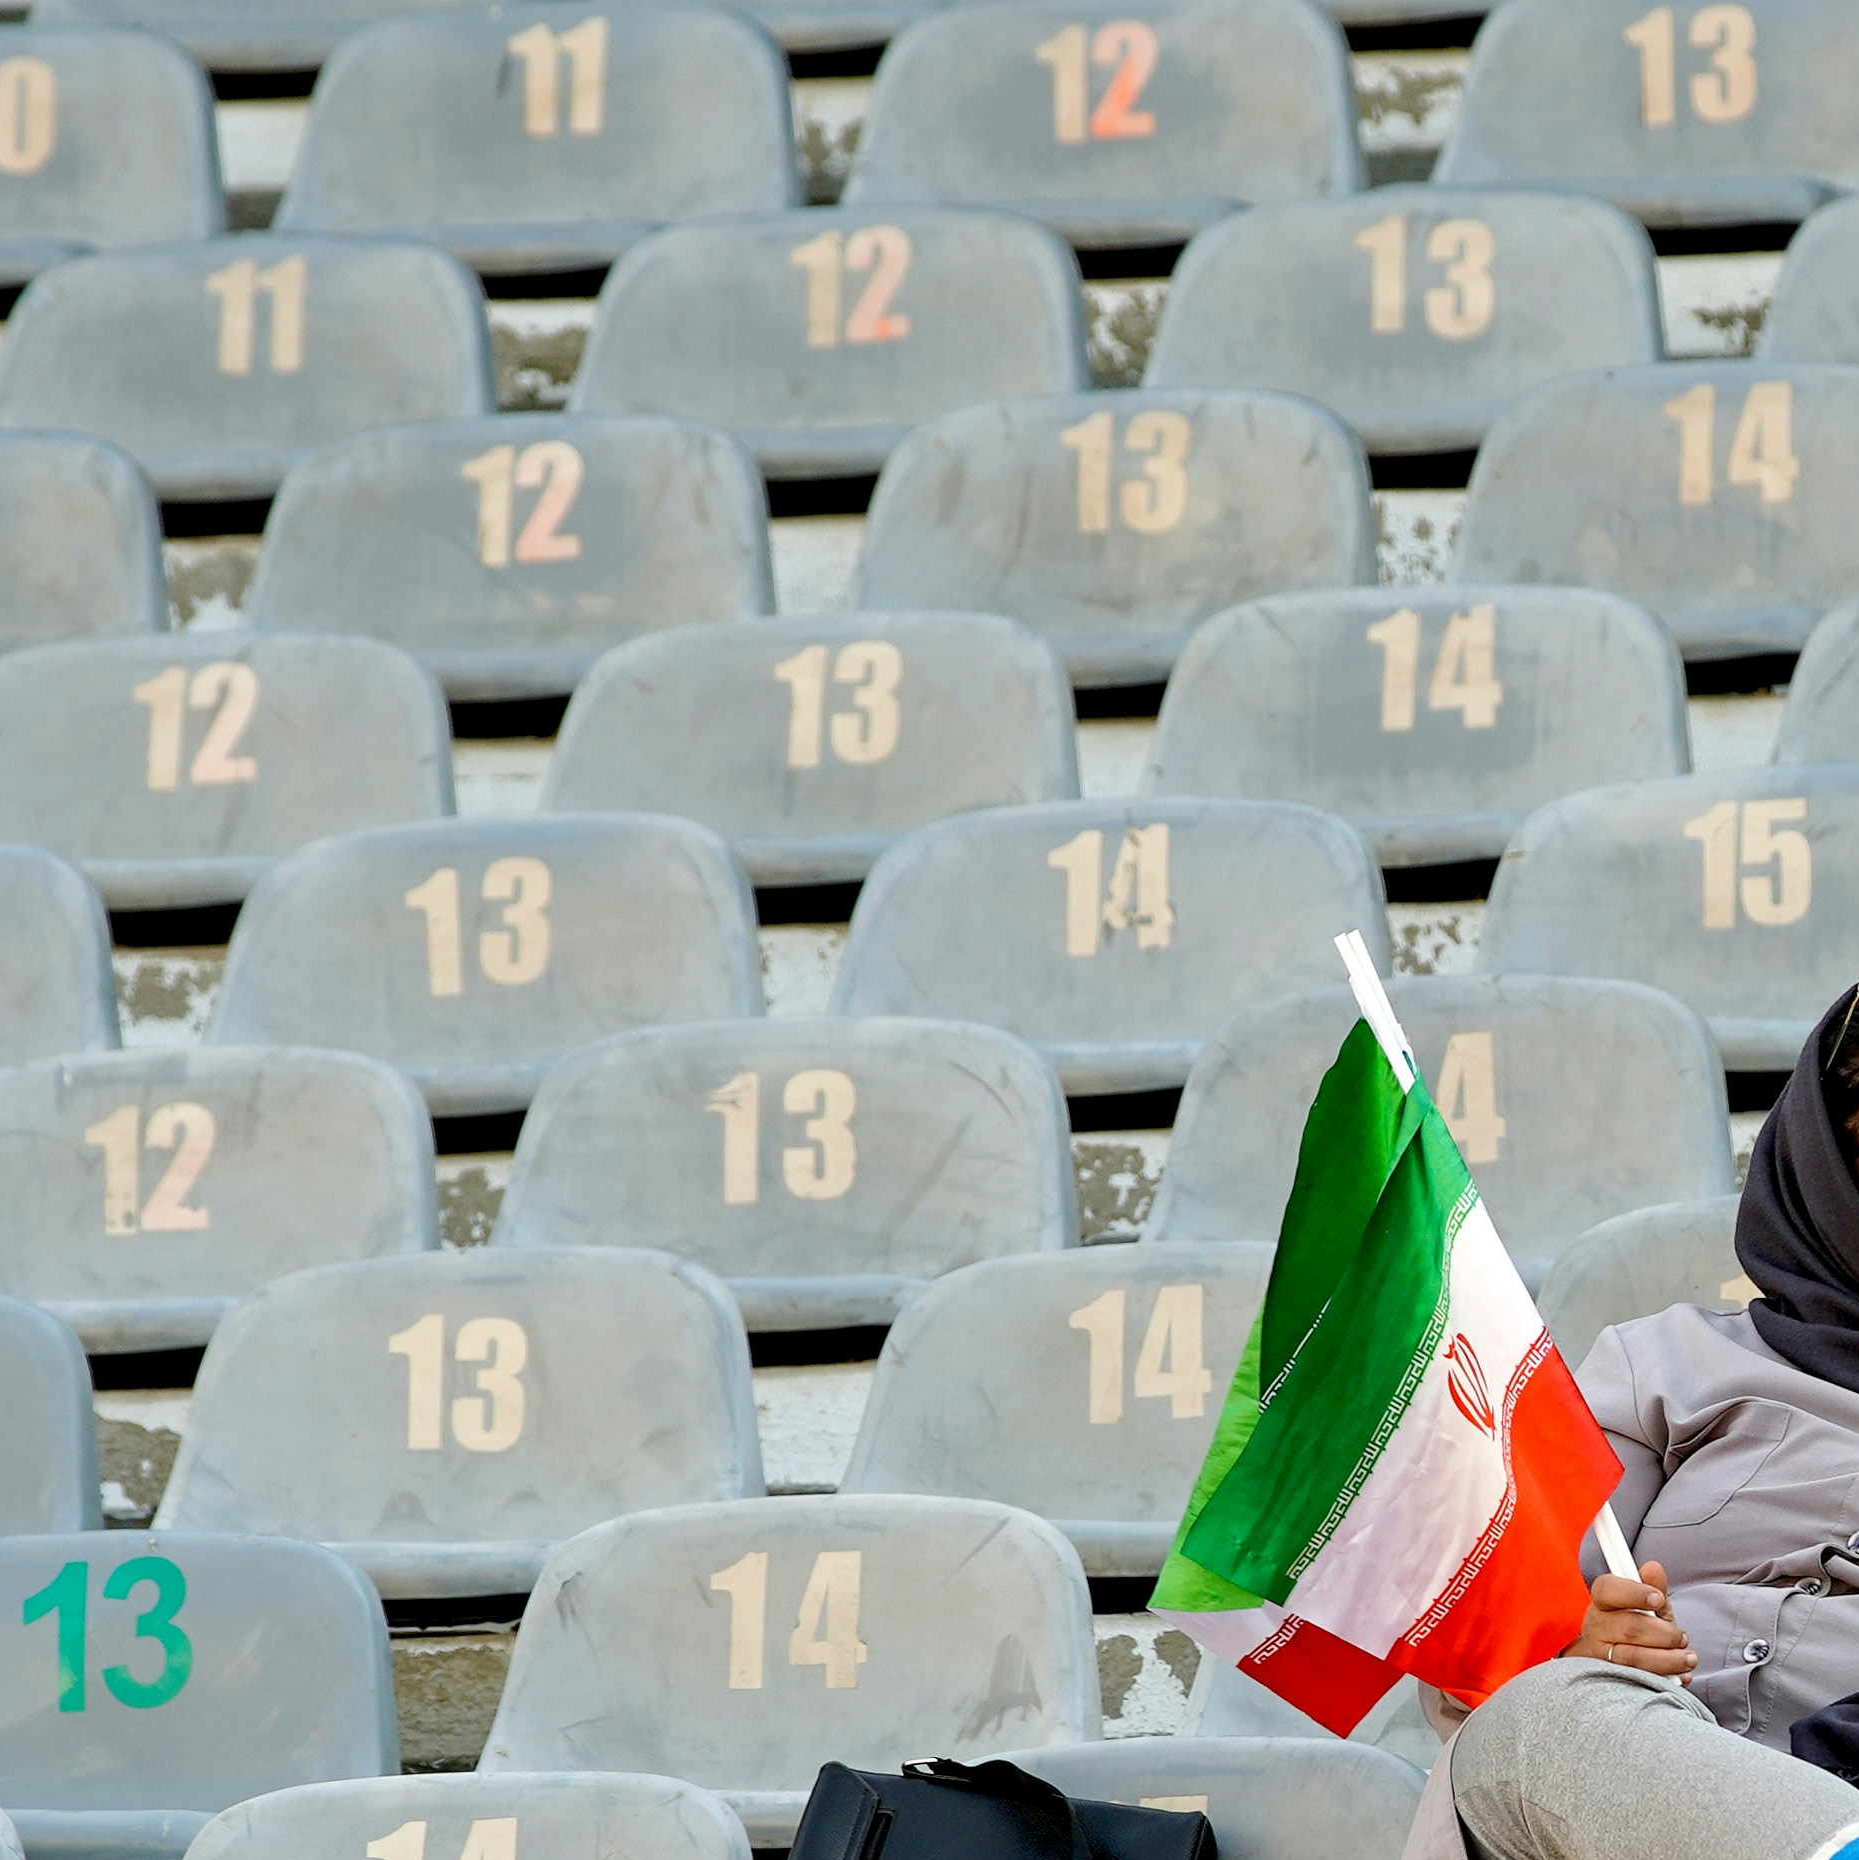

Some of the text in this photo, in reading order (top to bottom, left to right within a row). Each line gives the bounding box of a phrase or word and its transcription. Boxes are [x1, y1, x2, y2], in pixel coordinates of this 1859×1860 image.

[510, 21, 605, 137] 11
[1039, 22, 1157, 143] 12
[1625, 6, 1757, 125] 13
[207, 259, 305, 375] 11
[791, 227, 911, 349] 12
[1354, 215, 1495, 339] 13
[463, 443, 581, 567] 12
[1064, 414, 1199, 535] 13
[1664, 384, 1801, 506] 14
[133, 663, 260, 792] 12
[773, 642, 904, 769] 13
[1369, 607, 1502, 731] 14
[405, 858, 552, 997] 13
[1048, 825, 1175, 957] 14
[1683, 799, 1812, 930] 15
[708, 1069, 859, 1204] 13
[1436, 1031, 1506, 1164] 4
[83, 1101, 218, 1235] 12
[388, 1314, 528, 1452] 13
[1070, 1285, 1211, 1424] 14
[23, 1557, 192, 1712] 13
[710, 1551, 867, 1688] 14
